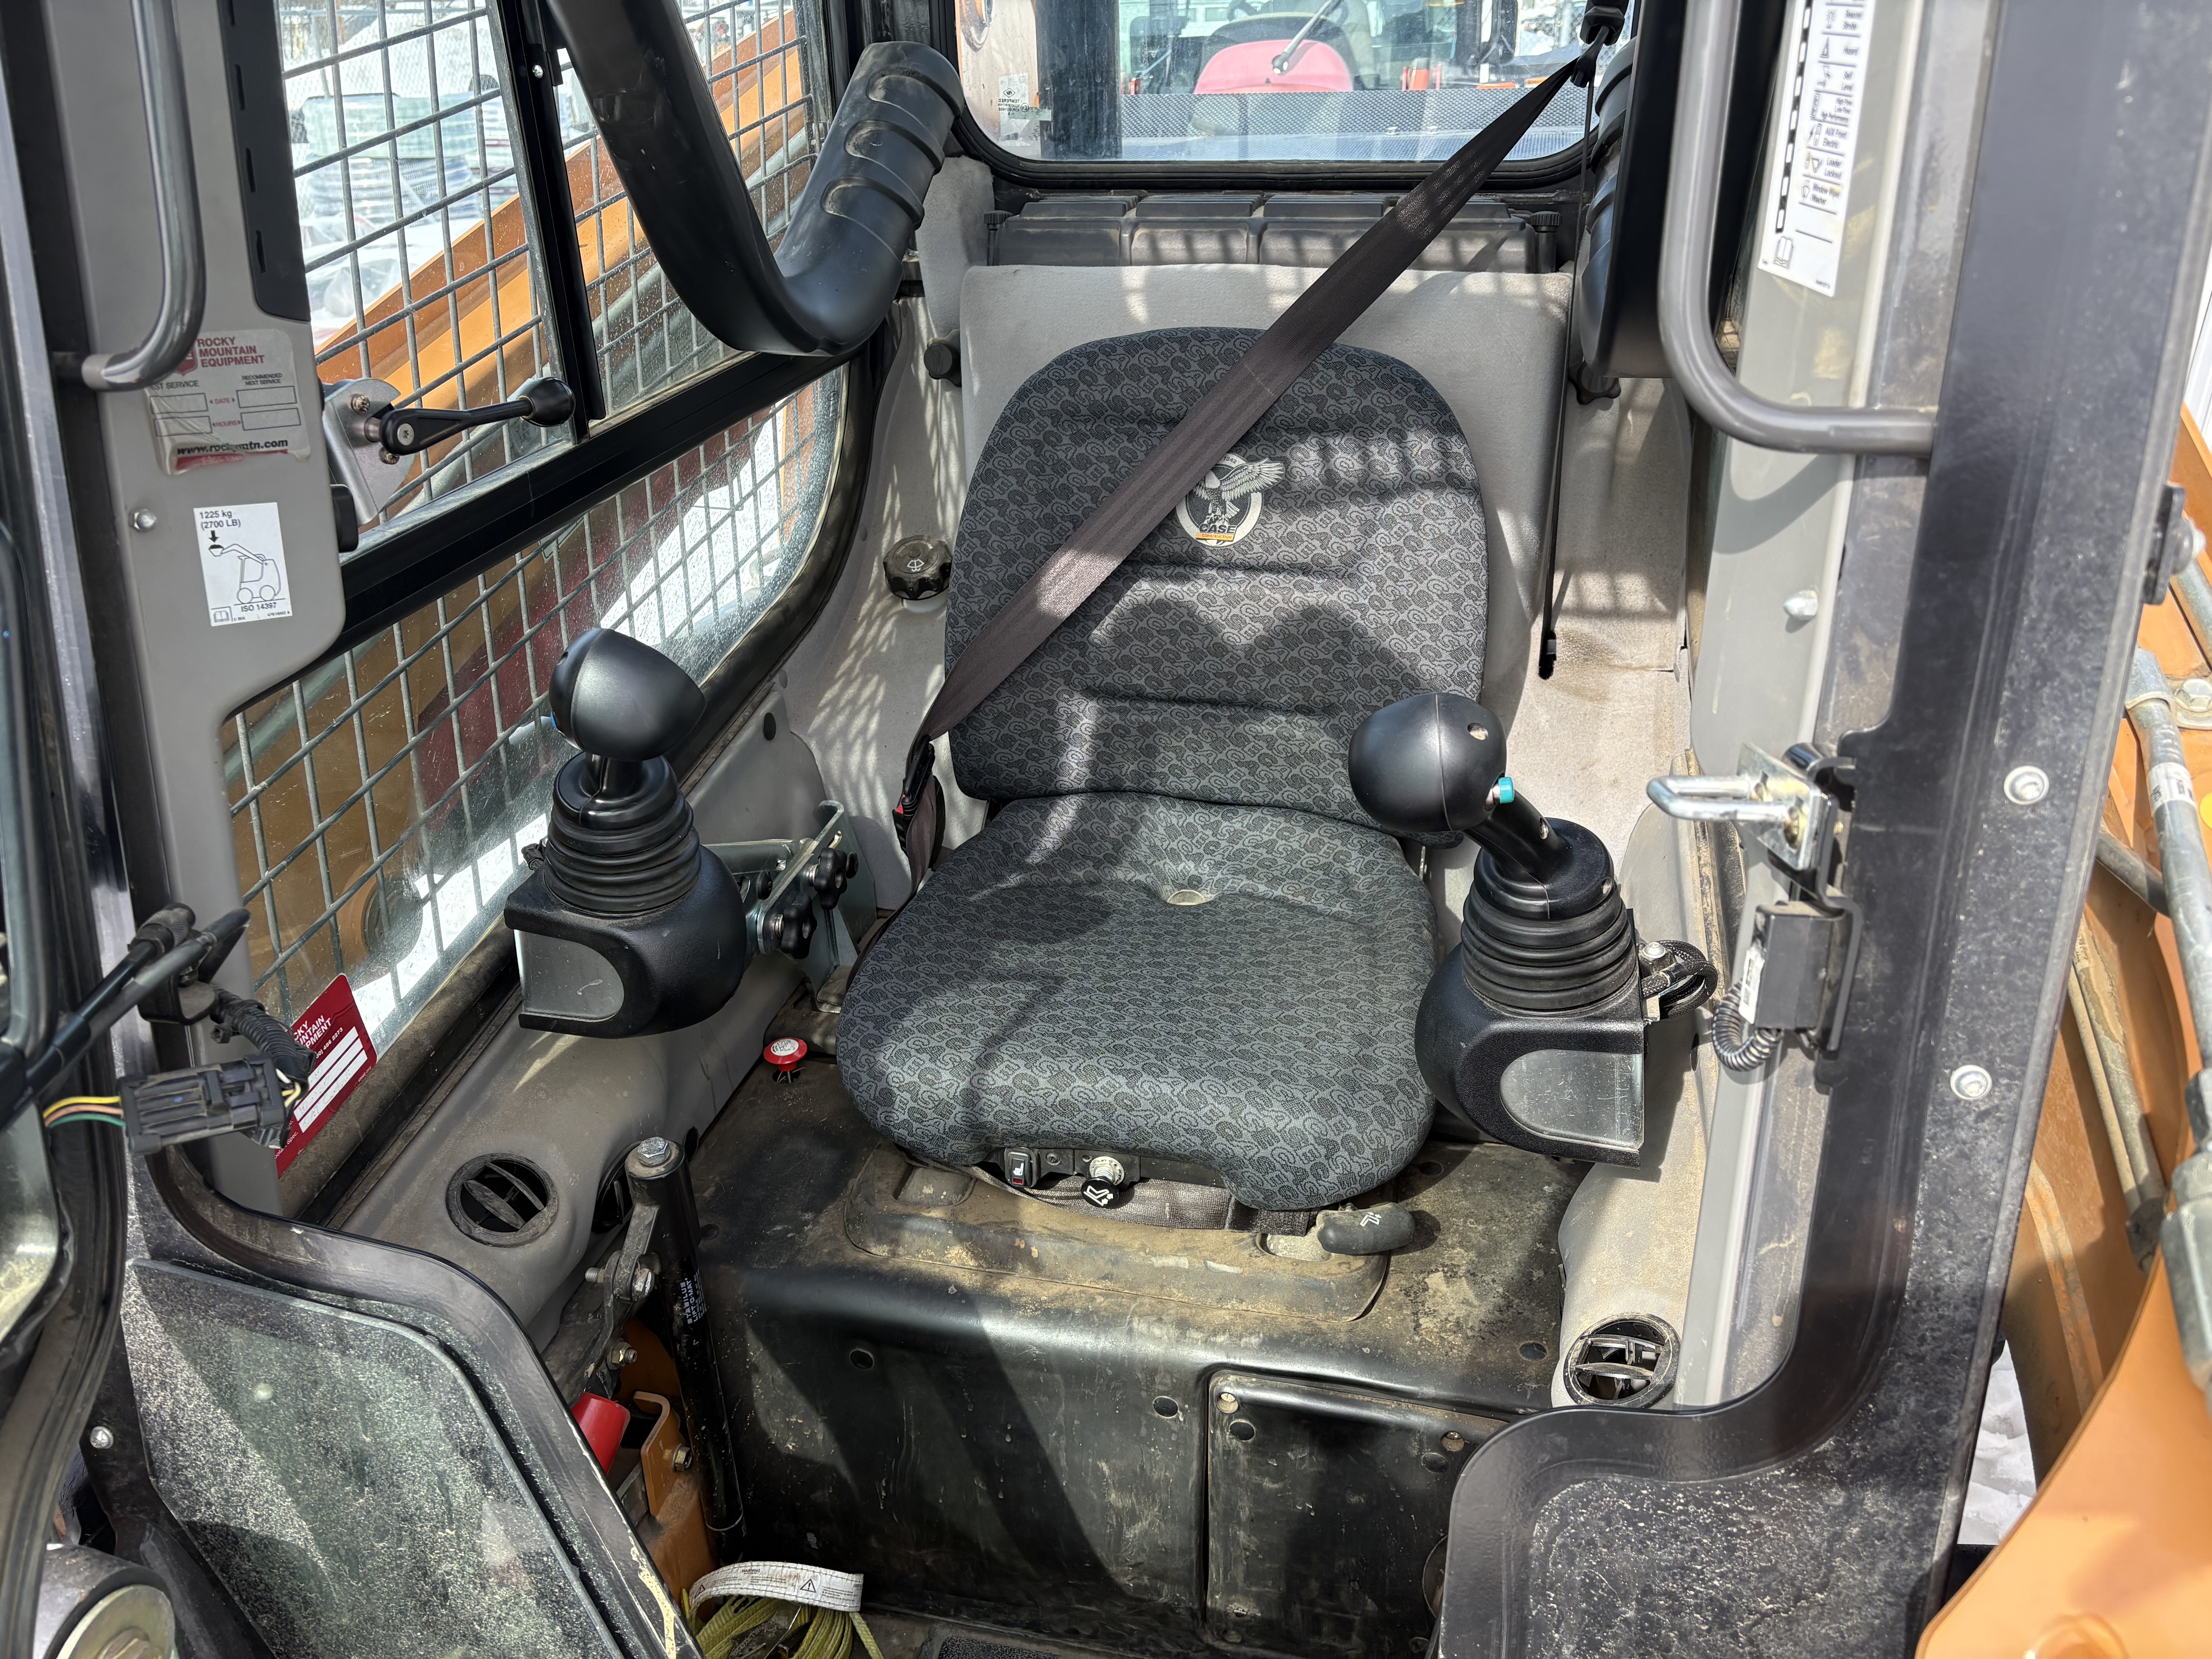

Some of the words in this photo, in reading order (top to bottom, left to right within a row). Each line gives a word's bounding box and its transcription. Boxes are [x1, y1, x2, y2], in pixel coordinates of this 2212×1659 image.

[1826, 157, 1842, 168] Loader
[1824, 168, 1842, 180] Lockout
[198, 337, 236, 347] ROCKY
[199, 345, 257, 357] MOUNTAIN
[201, 355, 265, 368] EQUIPMENT
[166, 380, 199, 389] SERVICE
[1223, 456, 1237, 464] 1842
[199, 510, 220, 519] 1225
[222, 510, 233, 519] kg
[201, 520, 224, 531] (2700
[226, 518, 241, 528] LB)
[1199, 523, 1237, 534] CASE
[256, 602, 277, 610] 14397
[294, 1020, 309, 1041] CKY
[331, 1027, 343, 1041] 2273
[680, 1281, 693, 1324] STABILUS
